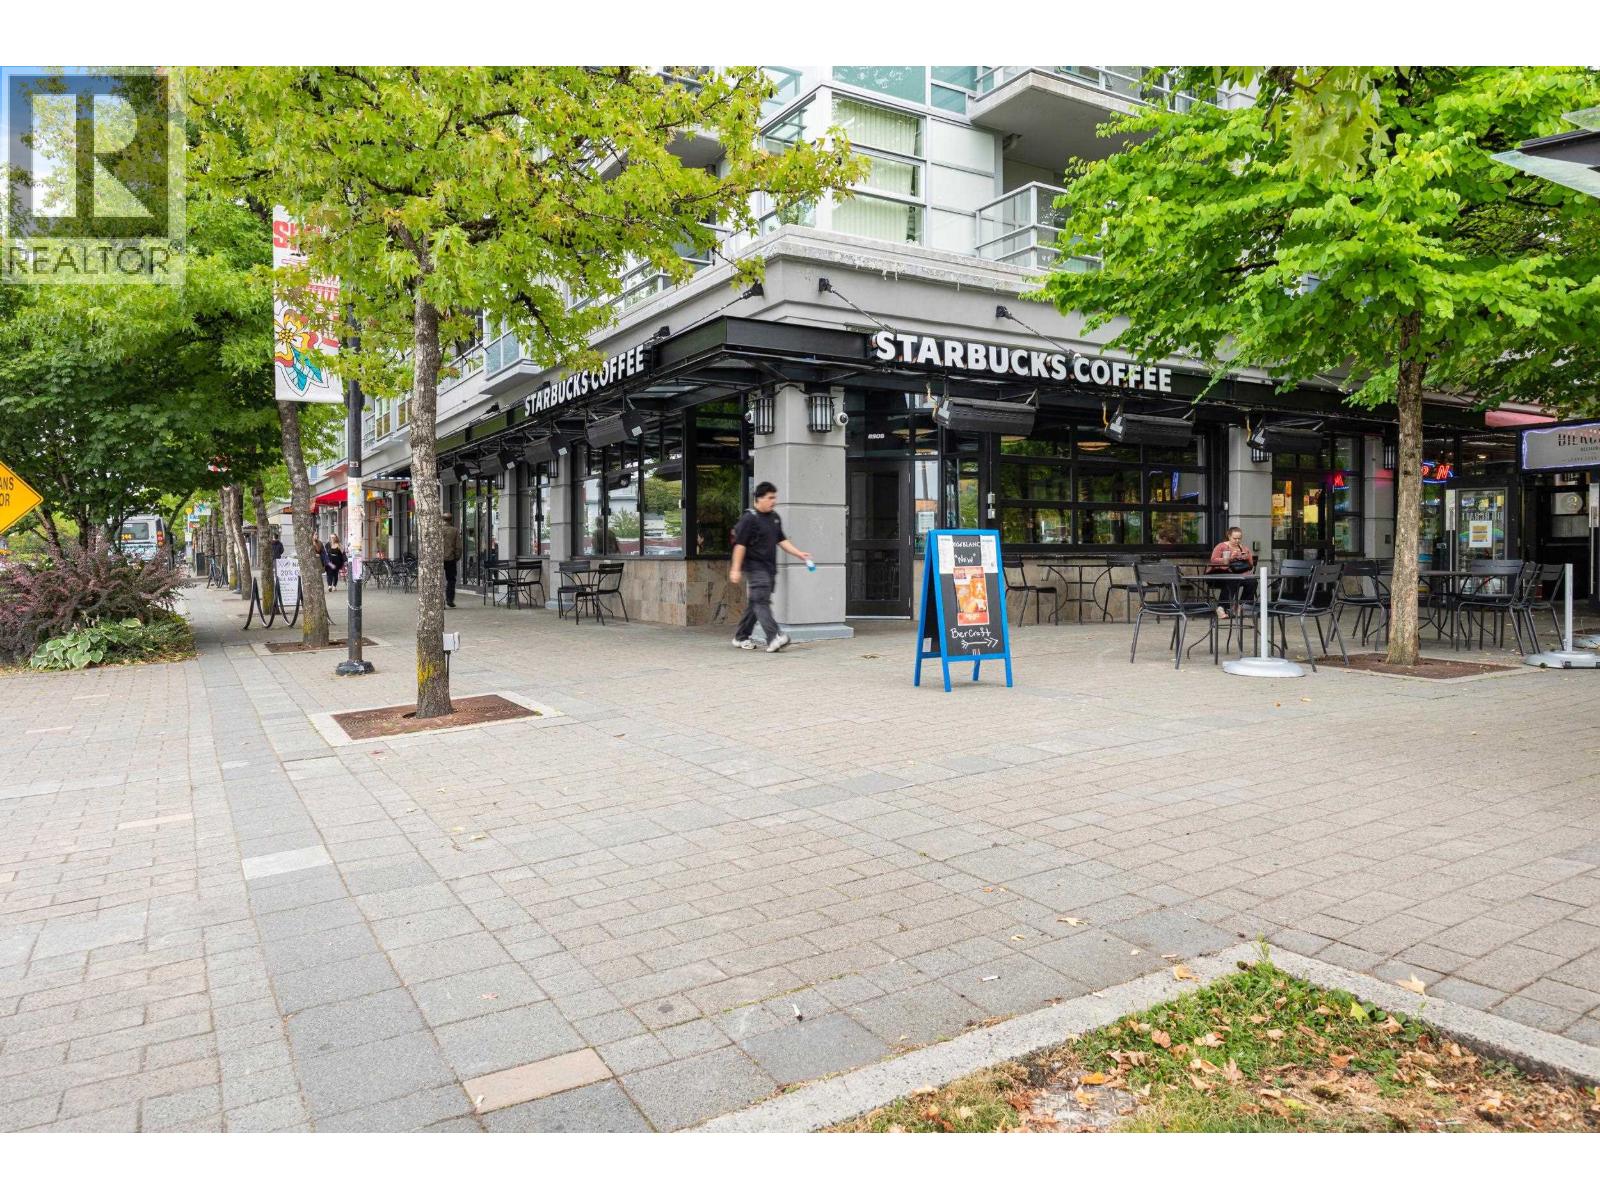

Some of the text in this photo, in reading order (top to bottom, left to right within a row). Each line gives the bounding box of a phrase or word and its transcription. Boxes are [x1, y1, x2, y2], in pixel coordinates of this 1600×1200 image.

[524, 344, 645, 417] STARBUCKS COFFEE
[875, 331, 1172, 392] STARBUCKS COFFEE
